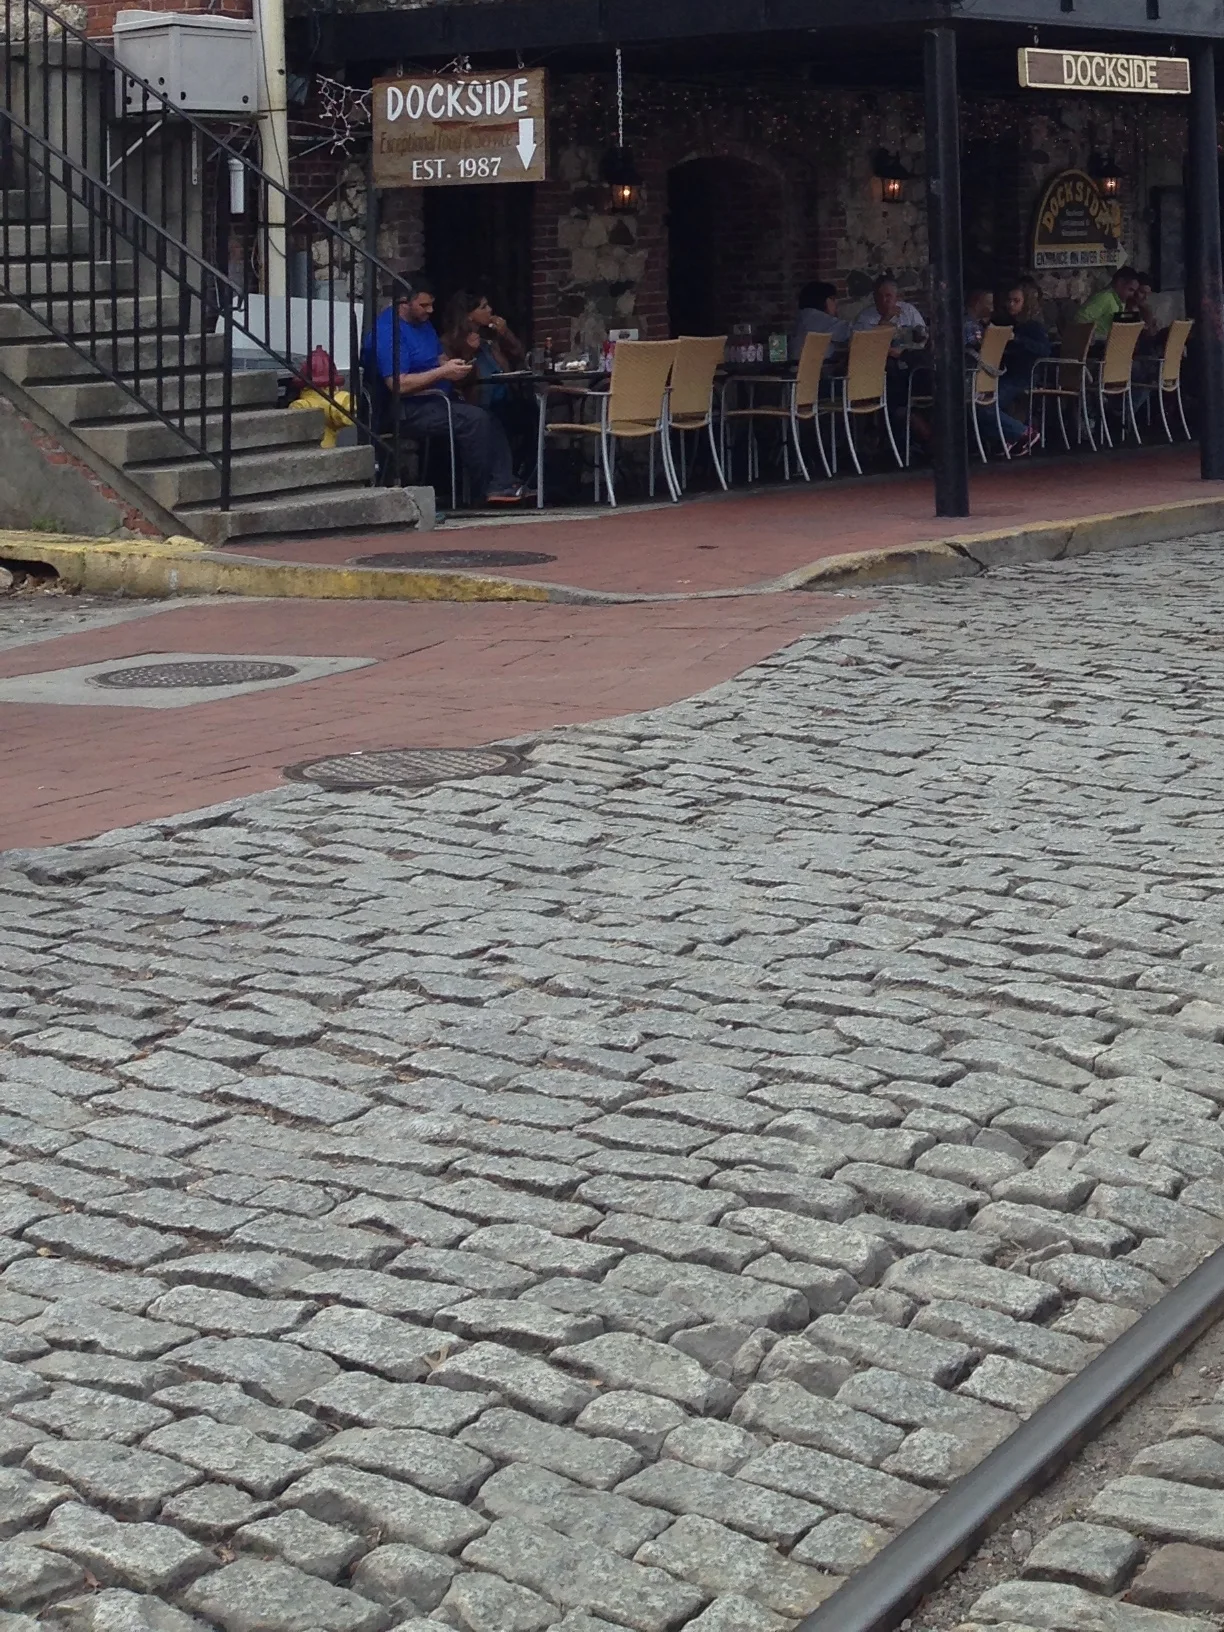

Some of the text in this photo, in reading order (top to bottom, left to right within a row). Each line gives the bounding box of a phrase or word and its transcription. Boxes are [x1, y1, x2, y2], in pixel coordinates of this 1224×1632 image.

[1062, 54, 1159, 90] DOCKSIDE
[386, 78, 529, 122] DOCKSIDE
[412, 157, 502, 180] EST. 1987
